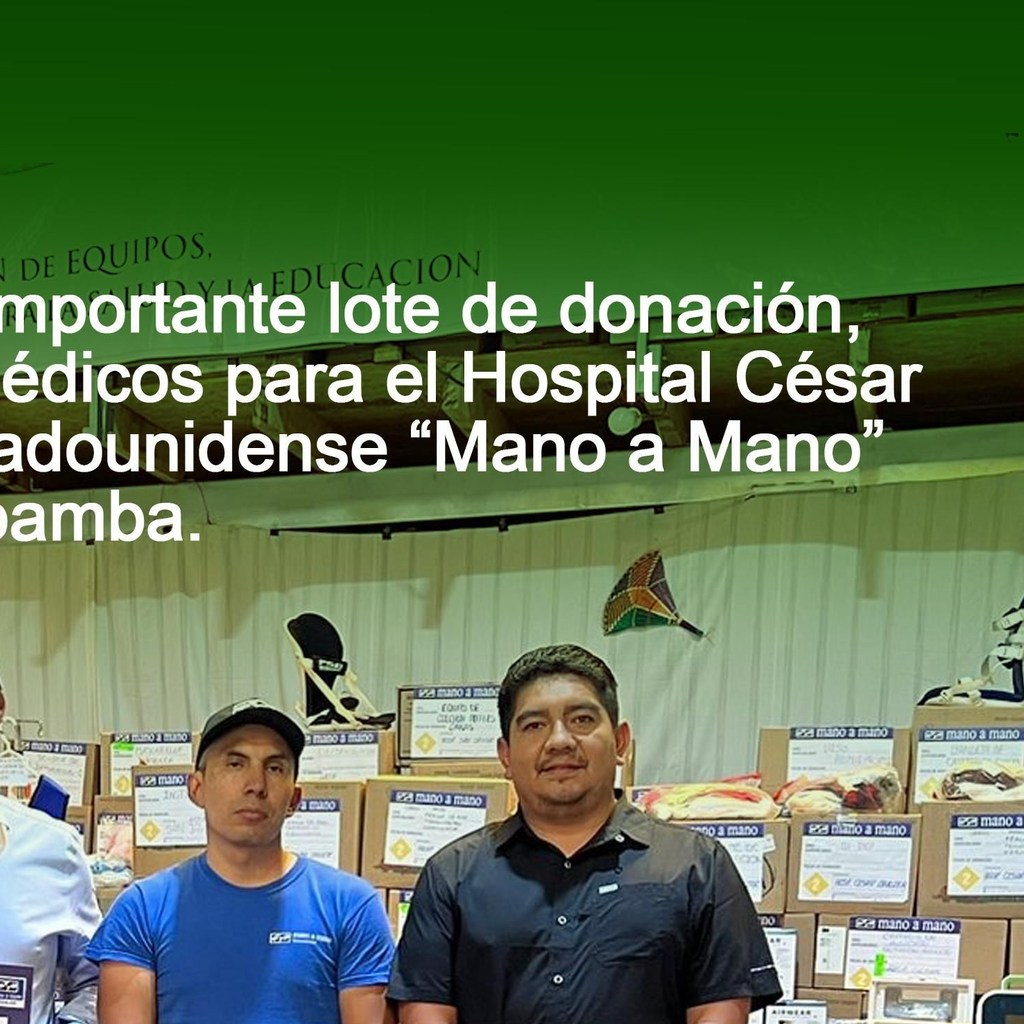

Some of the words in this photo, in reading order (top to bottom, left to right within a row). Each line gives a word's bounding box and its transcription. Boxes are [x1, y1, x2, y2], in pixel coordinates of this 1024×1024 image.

[21, 255, 56, 281] DE
[66, 231, 213, 276] EQUIPOS,
[271, 249, 482, 298] EDUCACION
[817, 727, 846, 738] mano
[848, 728, 855, 738] a
[858, 727, 888, 738] mano
[945, 729, 976, 740] mano
[979, 729, 986, 740] a
[989, 728, 1020, 740] mano
[158, 775, 184, 786] mano
[309, 799, 336, 811] mano
[415, 792, 444, 804] mano
[445, 794, 451, 805] a
[453, 794, 483, 807] mano
[980, 816, 1014, 828] mano
[1016, 817, 1024, 827] a
[726, 825, 759, 836] mano
[831, 824, 863, 835] mano
[864, 825, 872, 834] a
[874, 824, 907, 836] mano
[878, 918, 910, 931] mano
[912, 920, 919, 931] a
[922, 920, 956, 932] mano
